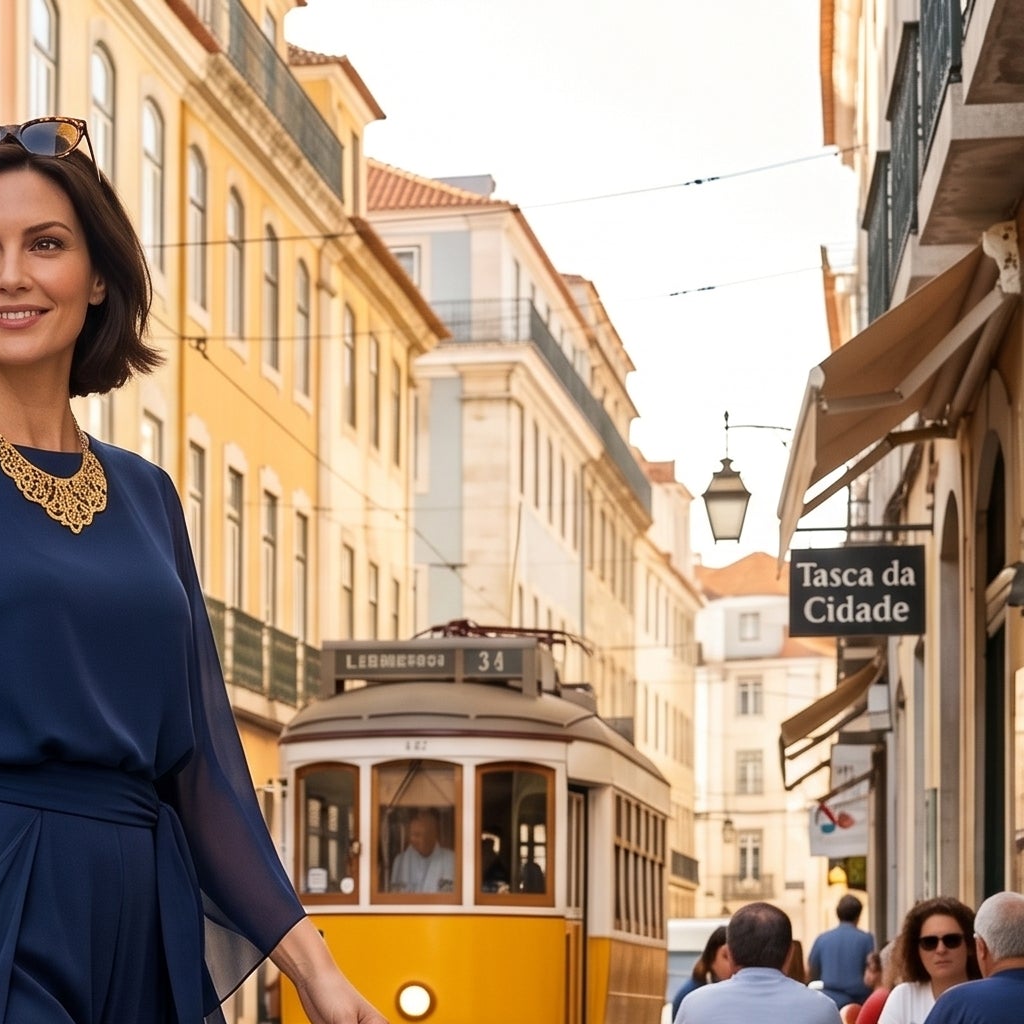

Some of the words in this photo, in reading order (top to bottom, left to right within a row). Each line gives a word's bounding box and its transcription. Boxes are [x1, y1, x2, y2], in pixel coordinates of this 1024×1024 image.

[796, 562, 875, 588] Tasca
[881, 559, 916, 587] da
[803, 595, 910, 624] Cidade
